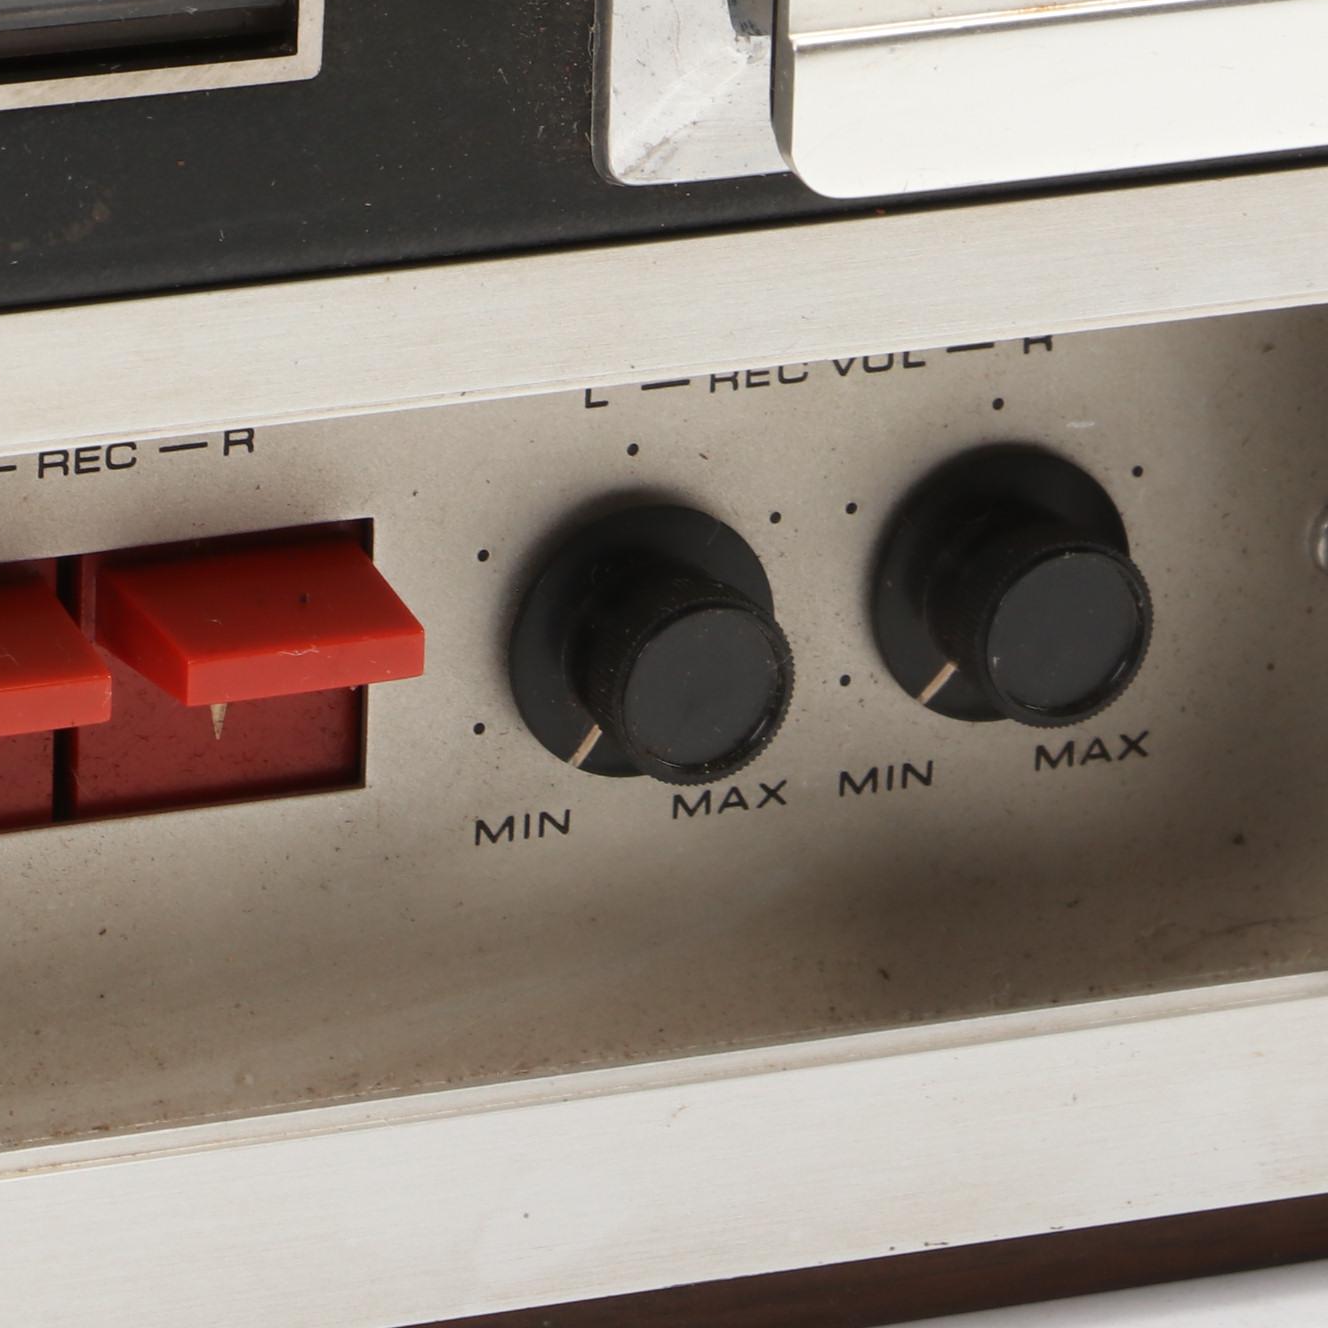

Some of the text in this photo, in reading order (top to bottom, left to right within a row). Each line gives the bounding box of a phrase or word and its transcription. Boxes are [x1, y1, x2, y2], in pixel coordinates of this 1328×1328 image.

[37, 441, 137, 480] REC
[223, 427, 255, 457] R
[1033, 728, 1150, 772] MAX
[839, 760, 934, 797] MIN
[671, 779, 787, 821] MAX
[474, 808, 571, 847] MIN
